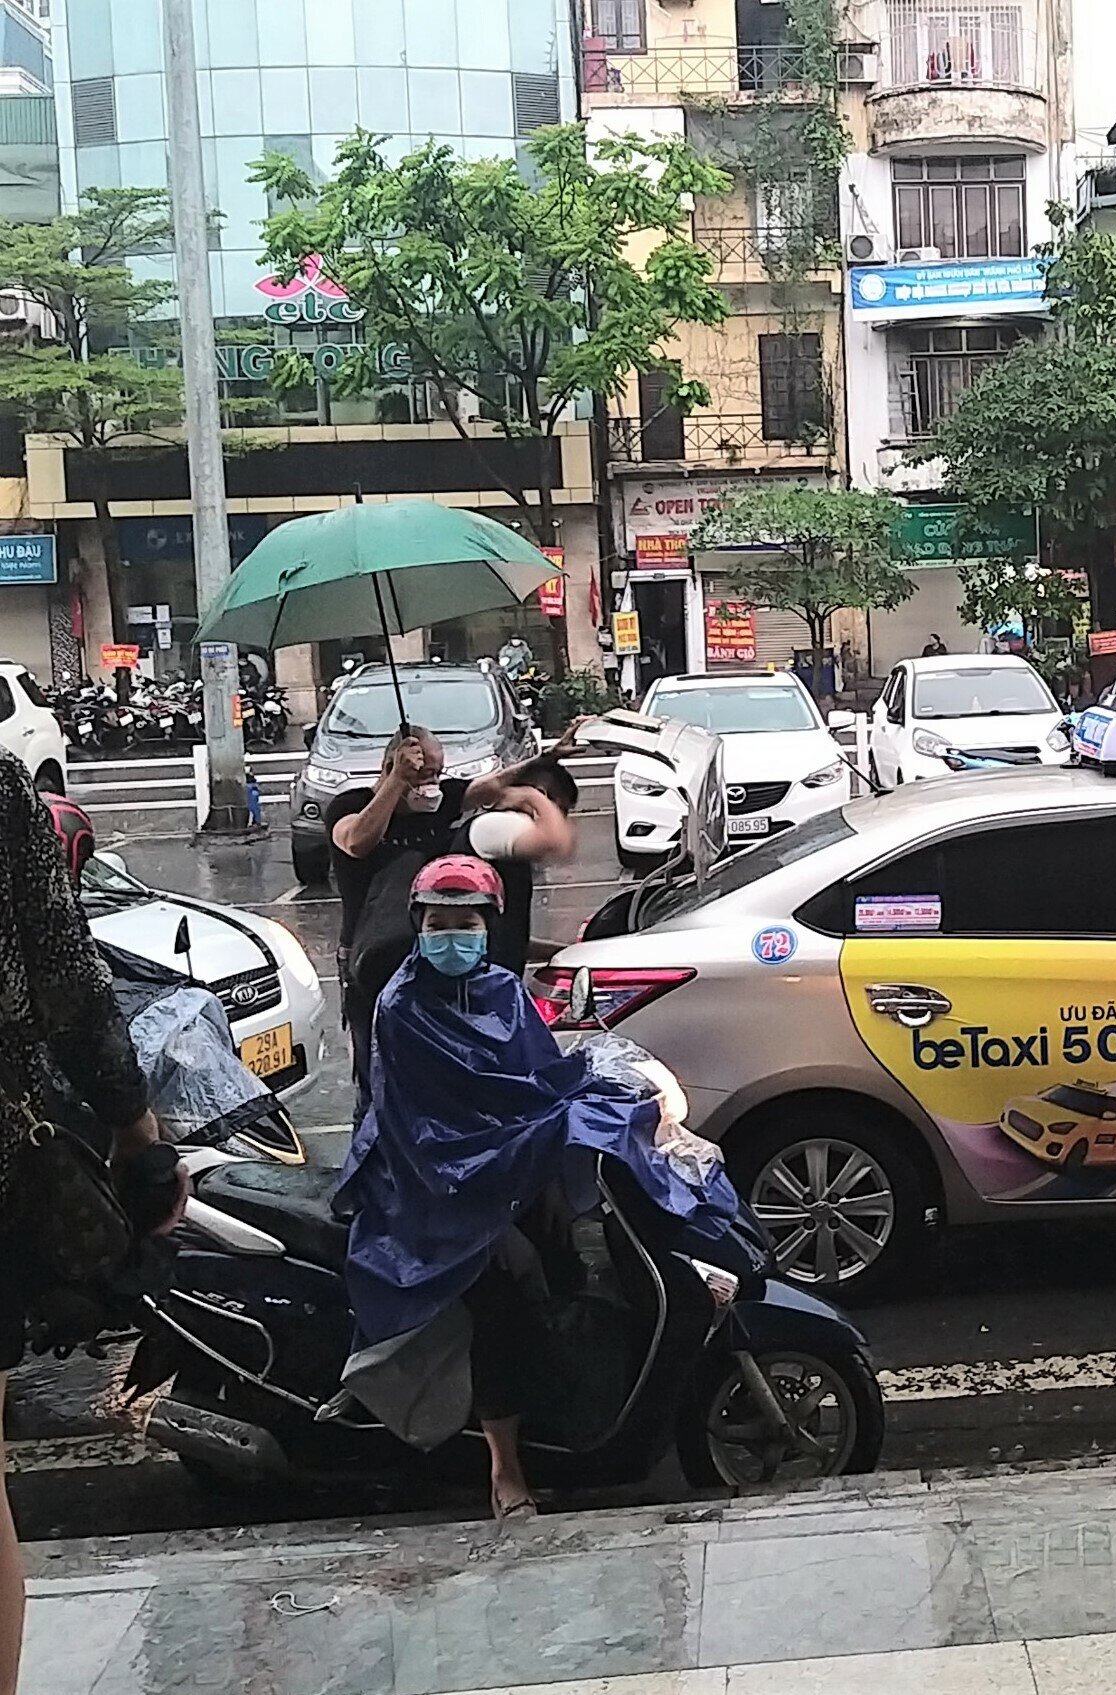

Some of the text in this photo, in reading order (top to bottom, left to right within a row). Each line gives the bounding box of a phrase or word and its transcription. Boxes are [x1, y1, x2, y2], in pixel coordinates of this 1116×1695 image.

[264, 291, 367, 323] etc
[655, 499, 694, 515] OPEN
[638, 537, 663, 551] NHÀ
[759, 932, 792, 959] 72
[236, 986, 254, 1002] KIA
[1060, 1003, 1086, 1021] ƯU
[256, 1031, 278, 1055] 29A
[912, 1026, 1049, 1070] beTaxi
